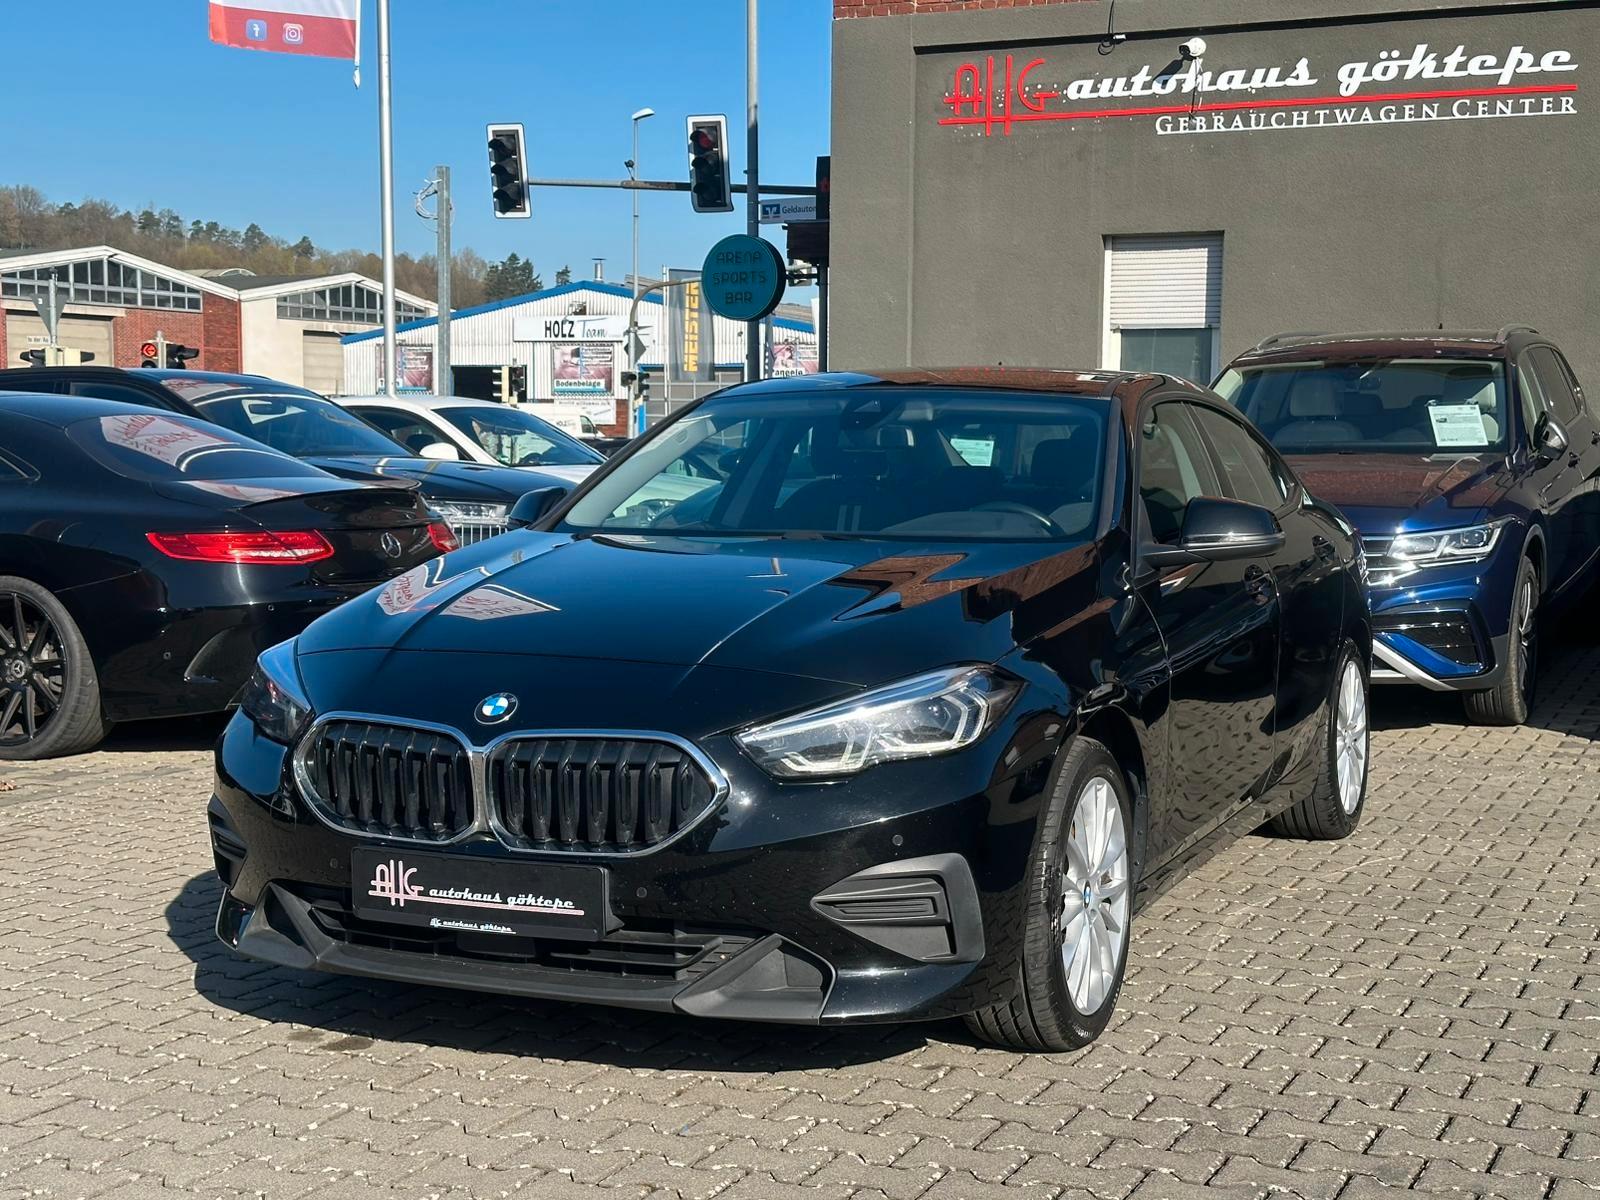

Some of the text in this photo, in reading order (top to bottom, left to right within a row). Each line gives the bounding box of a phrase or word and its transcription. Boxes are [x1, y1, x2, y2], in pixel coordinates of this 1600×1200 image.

[1067, 57, 1318, 101] autohaus
[1337, 43, 1579, 97] göktepe
[716, 251, 761, 264] ARENA
[713, 271, 766, 286] SPORTS
[725, 291, 752, 304] BAR
[544, 320, 575, 338] HOLZ
[429, 887, 502, 903] autohaus
[507, 893, 575, 909] göktepe
[443, 920, 478, 929] autohaus
